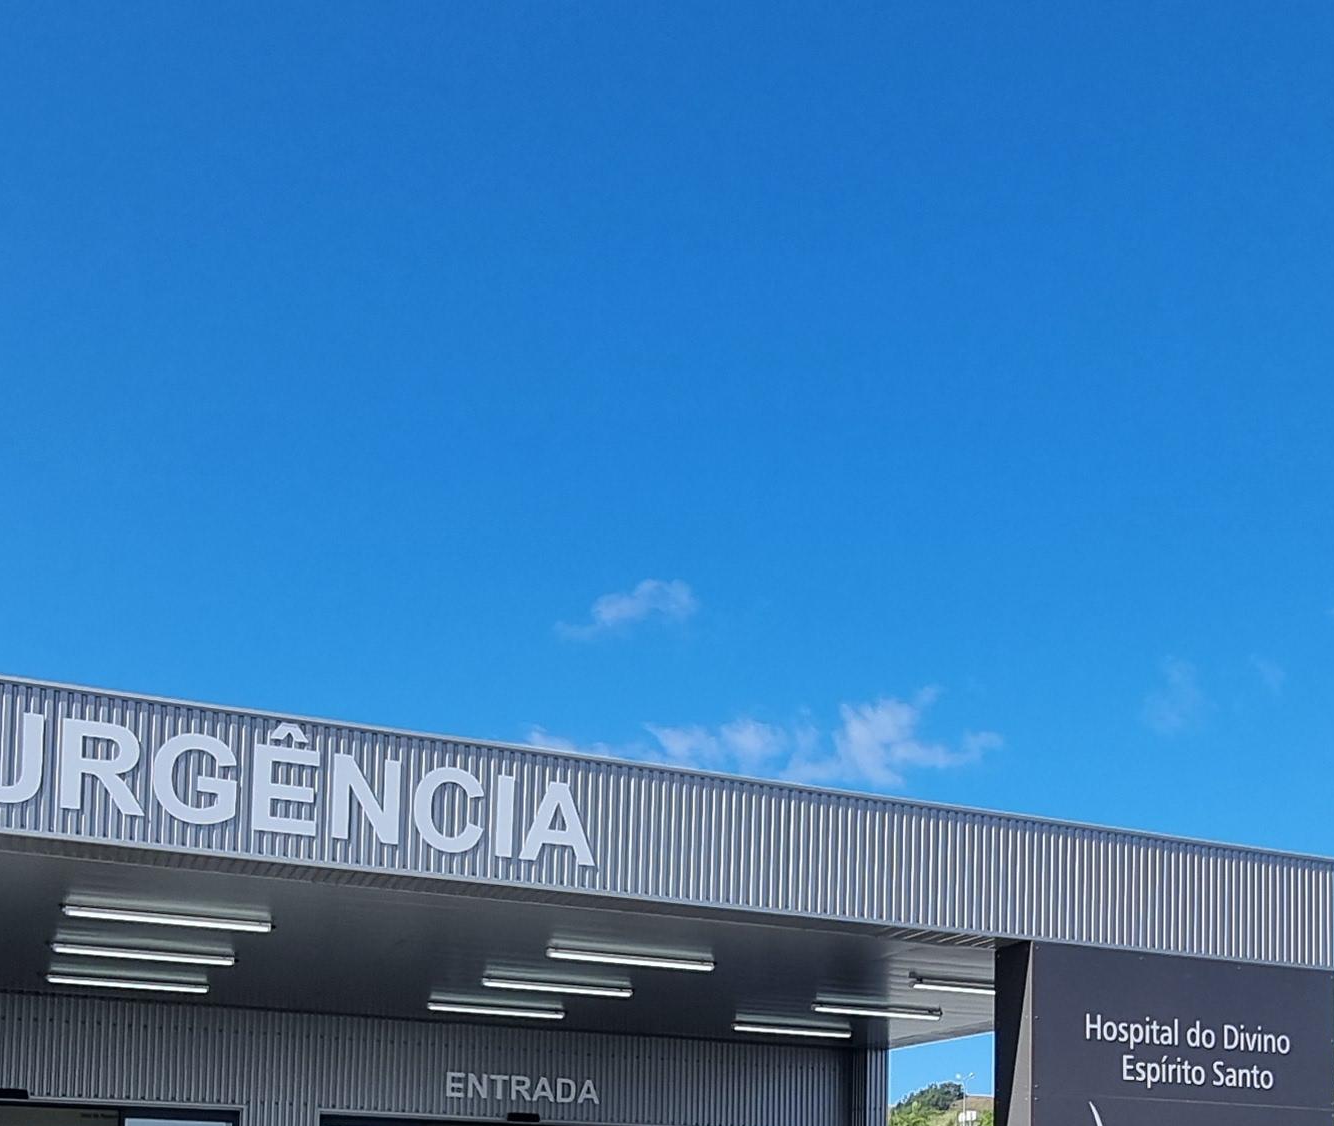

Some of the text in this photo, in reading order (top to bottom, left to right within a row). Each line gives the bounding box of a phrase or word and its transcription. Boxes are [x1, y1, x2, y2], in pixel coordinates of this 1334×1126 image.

[1085, 1013, 1290, 1054] Hospital do Divino
[446, 1071, 600, 1104] ENTRADA
[1122, 1054, 1274, 1089] Espírito Santo
